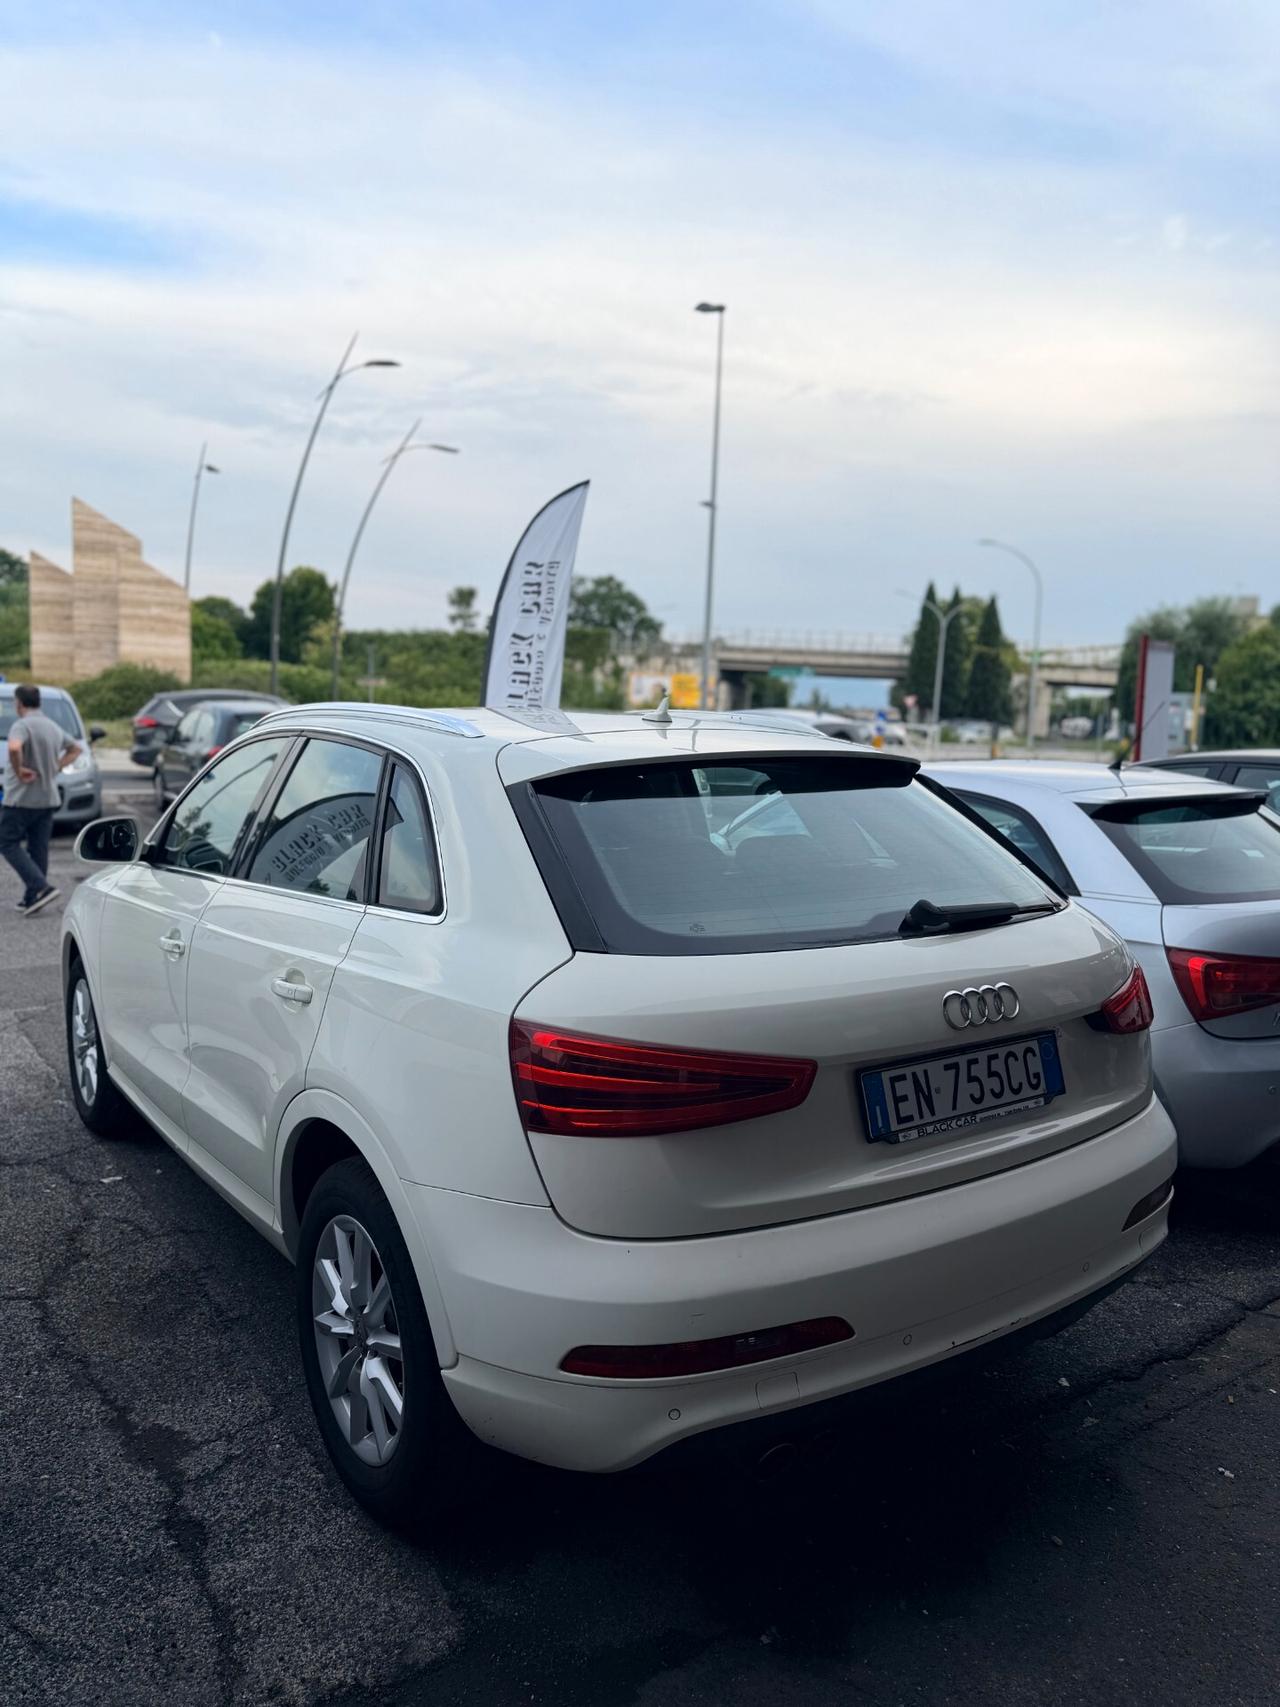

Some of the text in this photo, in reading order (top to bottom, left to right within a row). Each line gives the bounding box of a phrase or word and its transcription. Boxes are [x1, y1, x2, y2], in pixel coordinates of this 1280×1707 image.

[519, 561, 544, 617] CAR
[507, 632, 535, 709] LACK
[272, 804, 365, 873] BLACK CAR
[889, 1046, 1041, 1125] EN 755CG
[917, 1119, 954, 1138] BLACK
[955, 1115, 977, 1128] CAR
